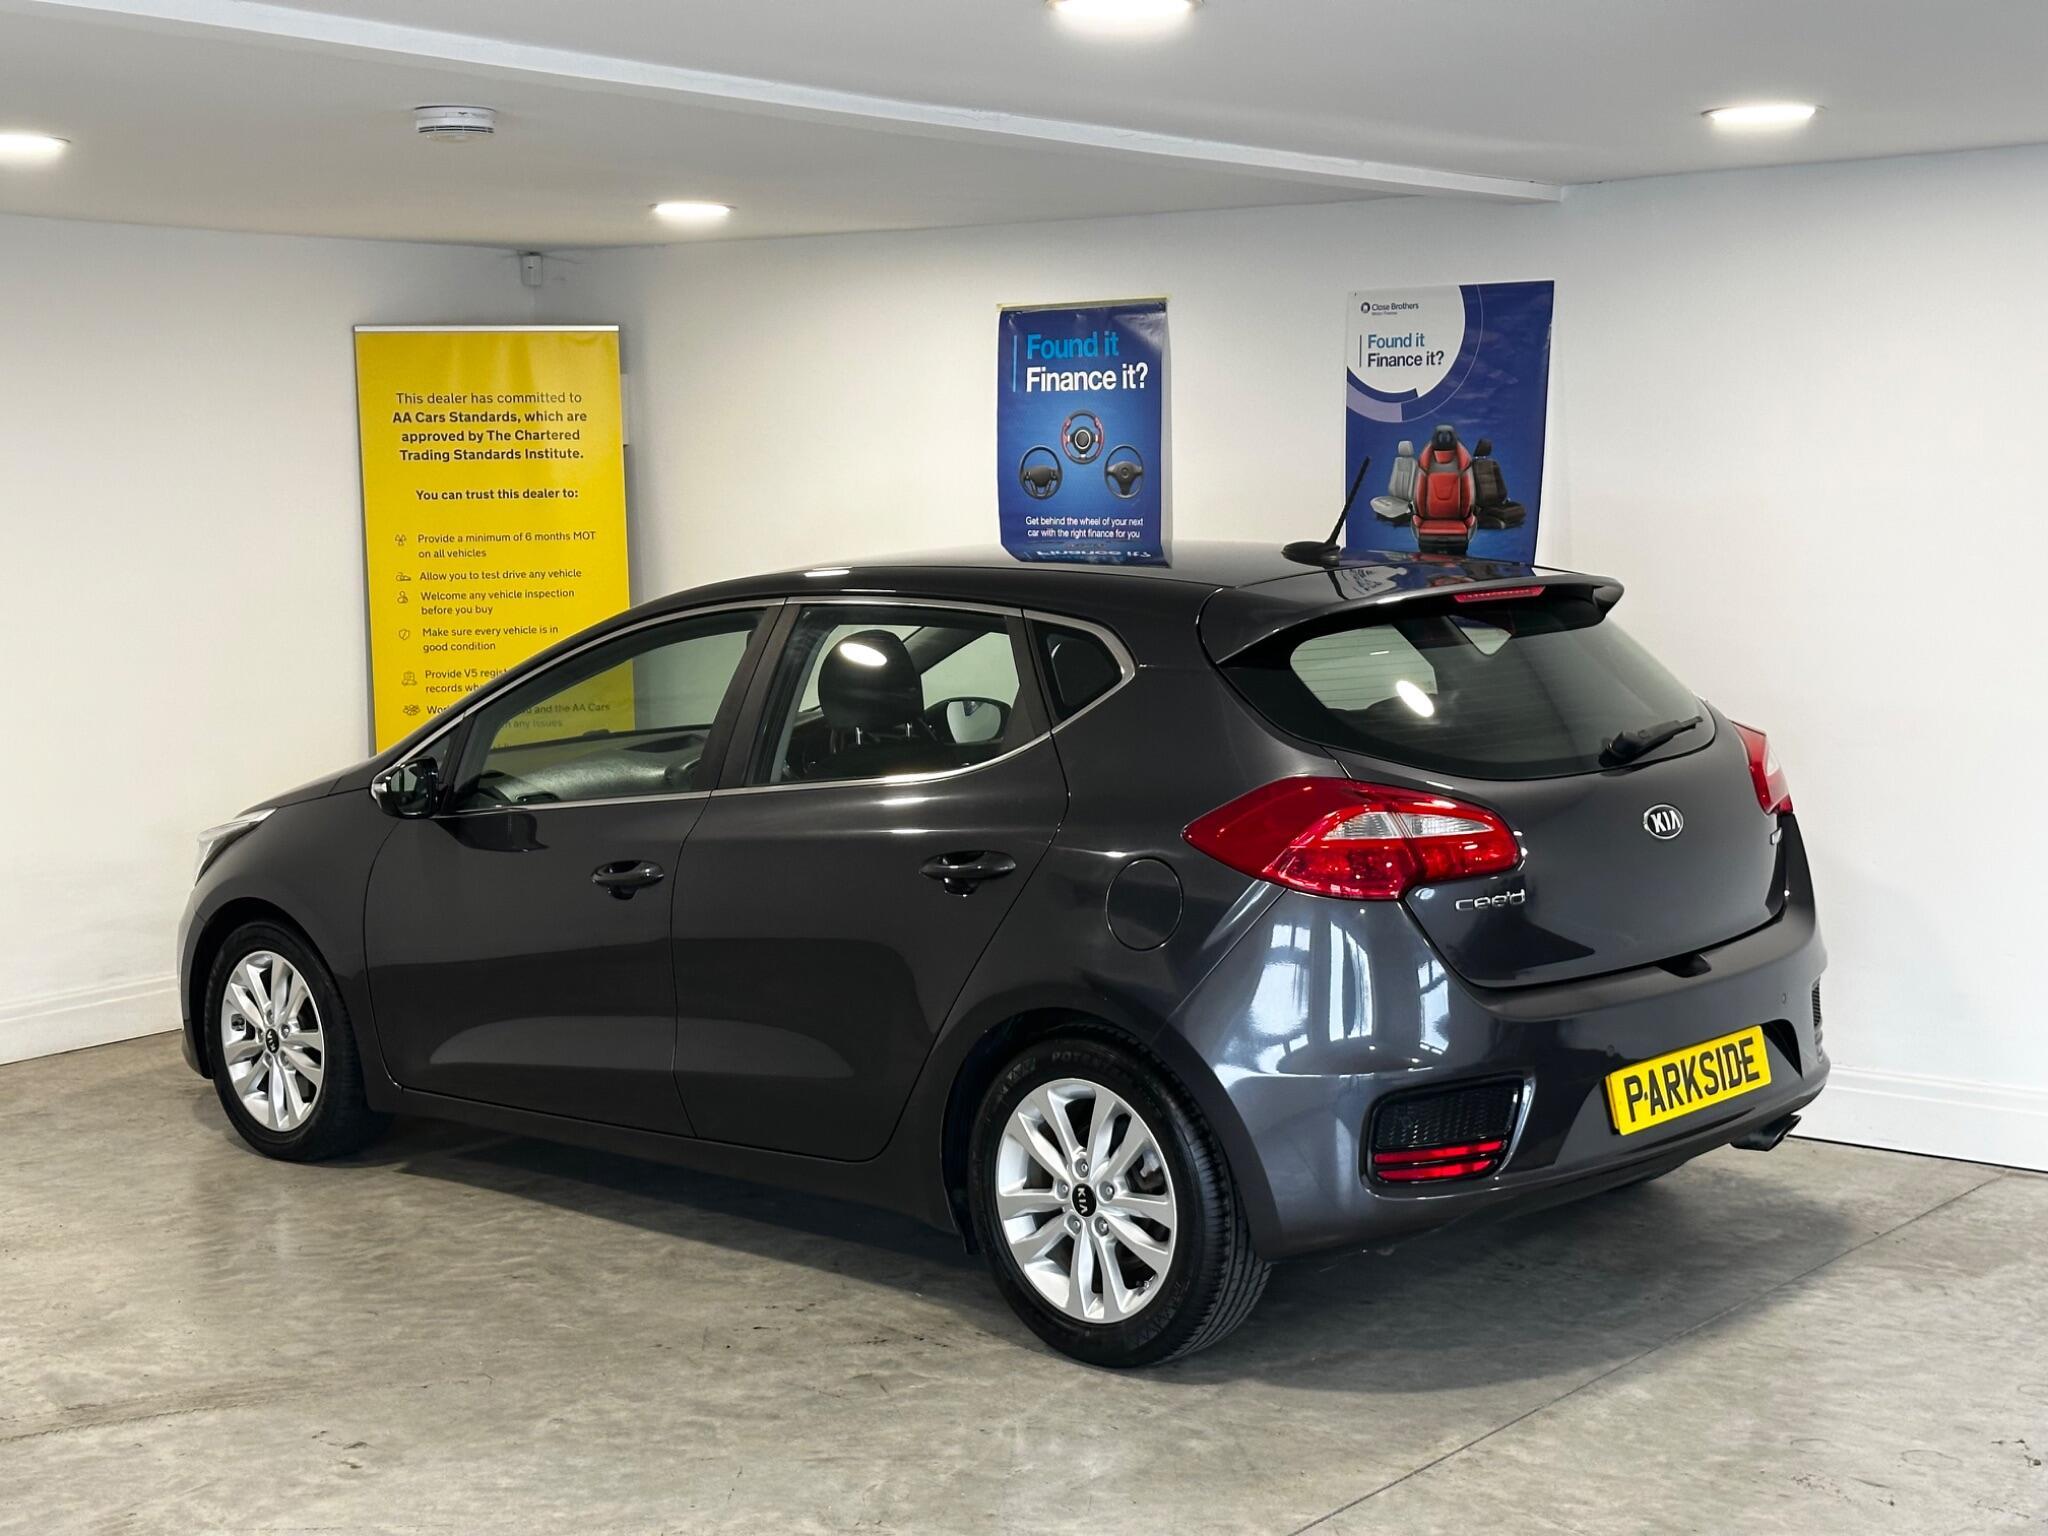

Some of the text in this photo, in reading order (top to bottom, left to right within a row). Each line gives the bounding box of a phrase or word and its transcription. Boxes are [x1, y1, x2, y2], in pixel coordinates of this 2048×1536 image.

[1371, 302, 1419, 311] Close Brothers
[1027, 330, 1119, 360] Found it
[1367, 332, 1425, 349] Found it
[1367, 350, 1444, 367] Finance it?
[1026, 362, 1149, 392] Finance it?
[396, 392, 582, 404] This dealer has committed to
[392, 410, 587, 423] AA Cars Standards, which are
[402, 429, 580, 443] approved by The Chartered
[399, 448, 584, 462] Trading Standards Institute.
[416, 488, 578, 500] You can trust this dealer to:
[1025, 516, 1144, 527] Get behind the wheel of your next
[417, 534, 455, 543] Provide
[465, 533, 511, 542] minimum
[513, 533, 523, 541] of
[525, 532, 532, 541] 6
[534, 532, 571, 541] months
[573, 531, 596, 540] MOT
[1041, 528, 1056, 537] with
[1057, 529, 1069, 537] the
[1071, 529, 1087, 539] right
[1088, 528, 1114, 538] finance
[1115, 529, 1126, 538] for
[1127, 531, 1141, 540] you
[433, 549, 444, 558] all
[447, 548, 487, 557] vehicles
[420, 572, 447, 580] Allow
[449, 573, 466, 581] you
[482, 571, 500, 579] test
[502, 571, 527, 579] drive
[529, 571, 546, 579] any
[548, 569, 582, 577] vehicle
[421, 589, 575, 600] Welcome any vehicle inspection
[421, 605, 493, 615] before you buy
[422, 628, 449, 636] Make
[475, 628, 501, 636] every
[503, 626, 537, 635] vehicle
[540, 625, 547, 633] is
[423, 642, 496, 653] good condition
[425, 669, 462, 679] Provide
[464, 669, 478, 678] V5
[426, 684, 462, 693] records
[534, 705, 552, 713] and
[555, 704, 570, 713] the
[572, 704, 586, 712] AA
[588, 703, 611, 711] Cars
[513, 720, 530, 729] any
[533, 719, 563, 728] issues
[1650, 810, 1680, 833] KIA
[1623, 1036, 1761, 1123] PARKSIDE
[1077, 1187, 1088, 1214] KIA
